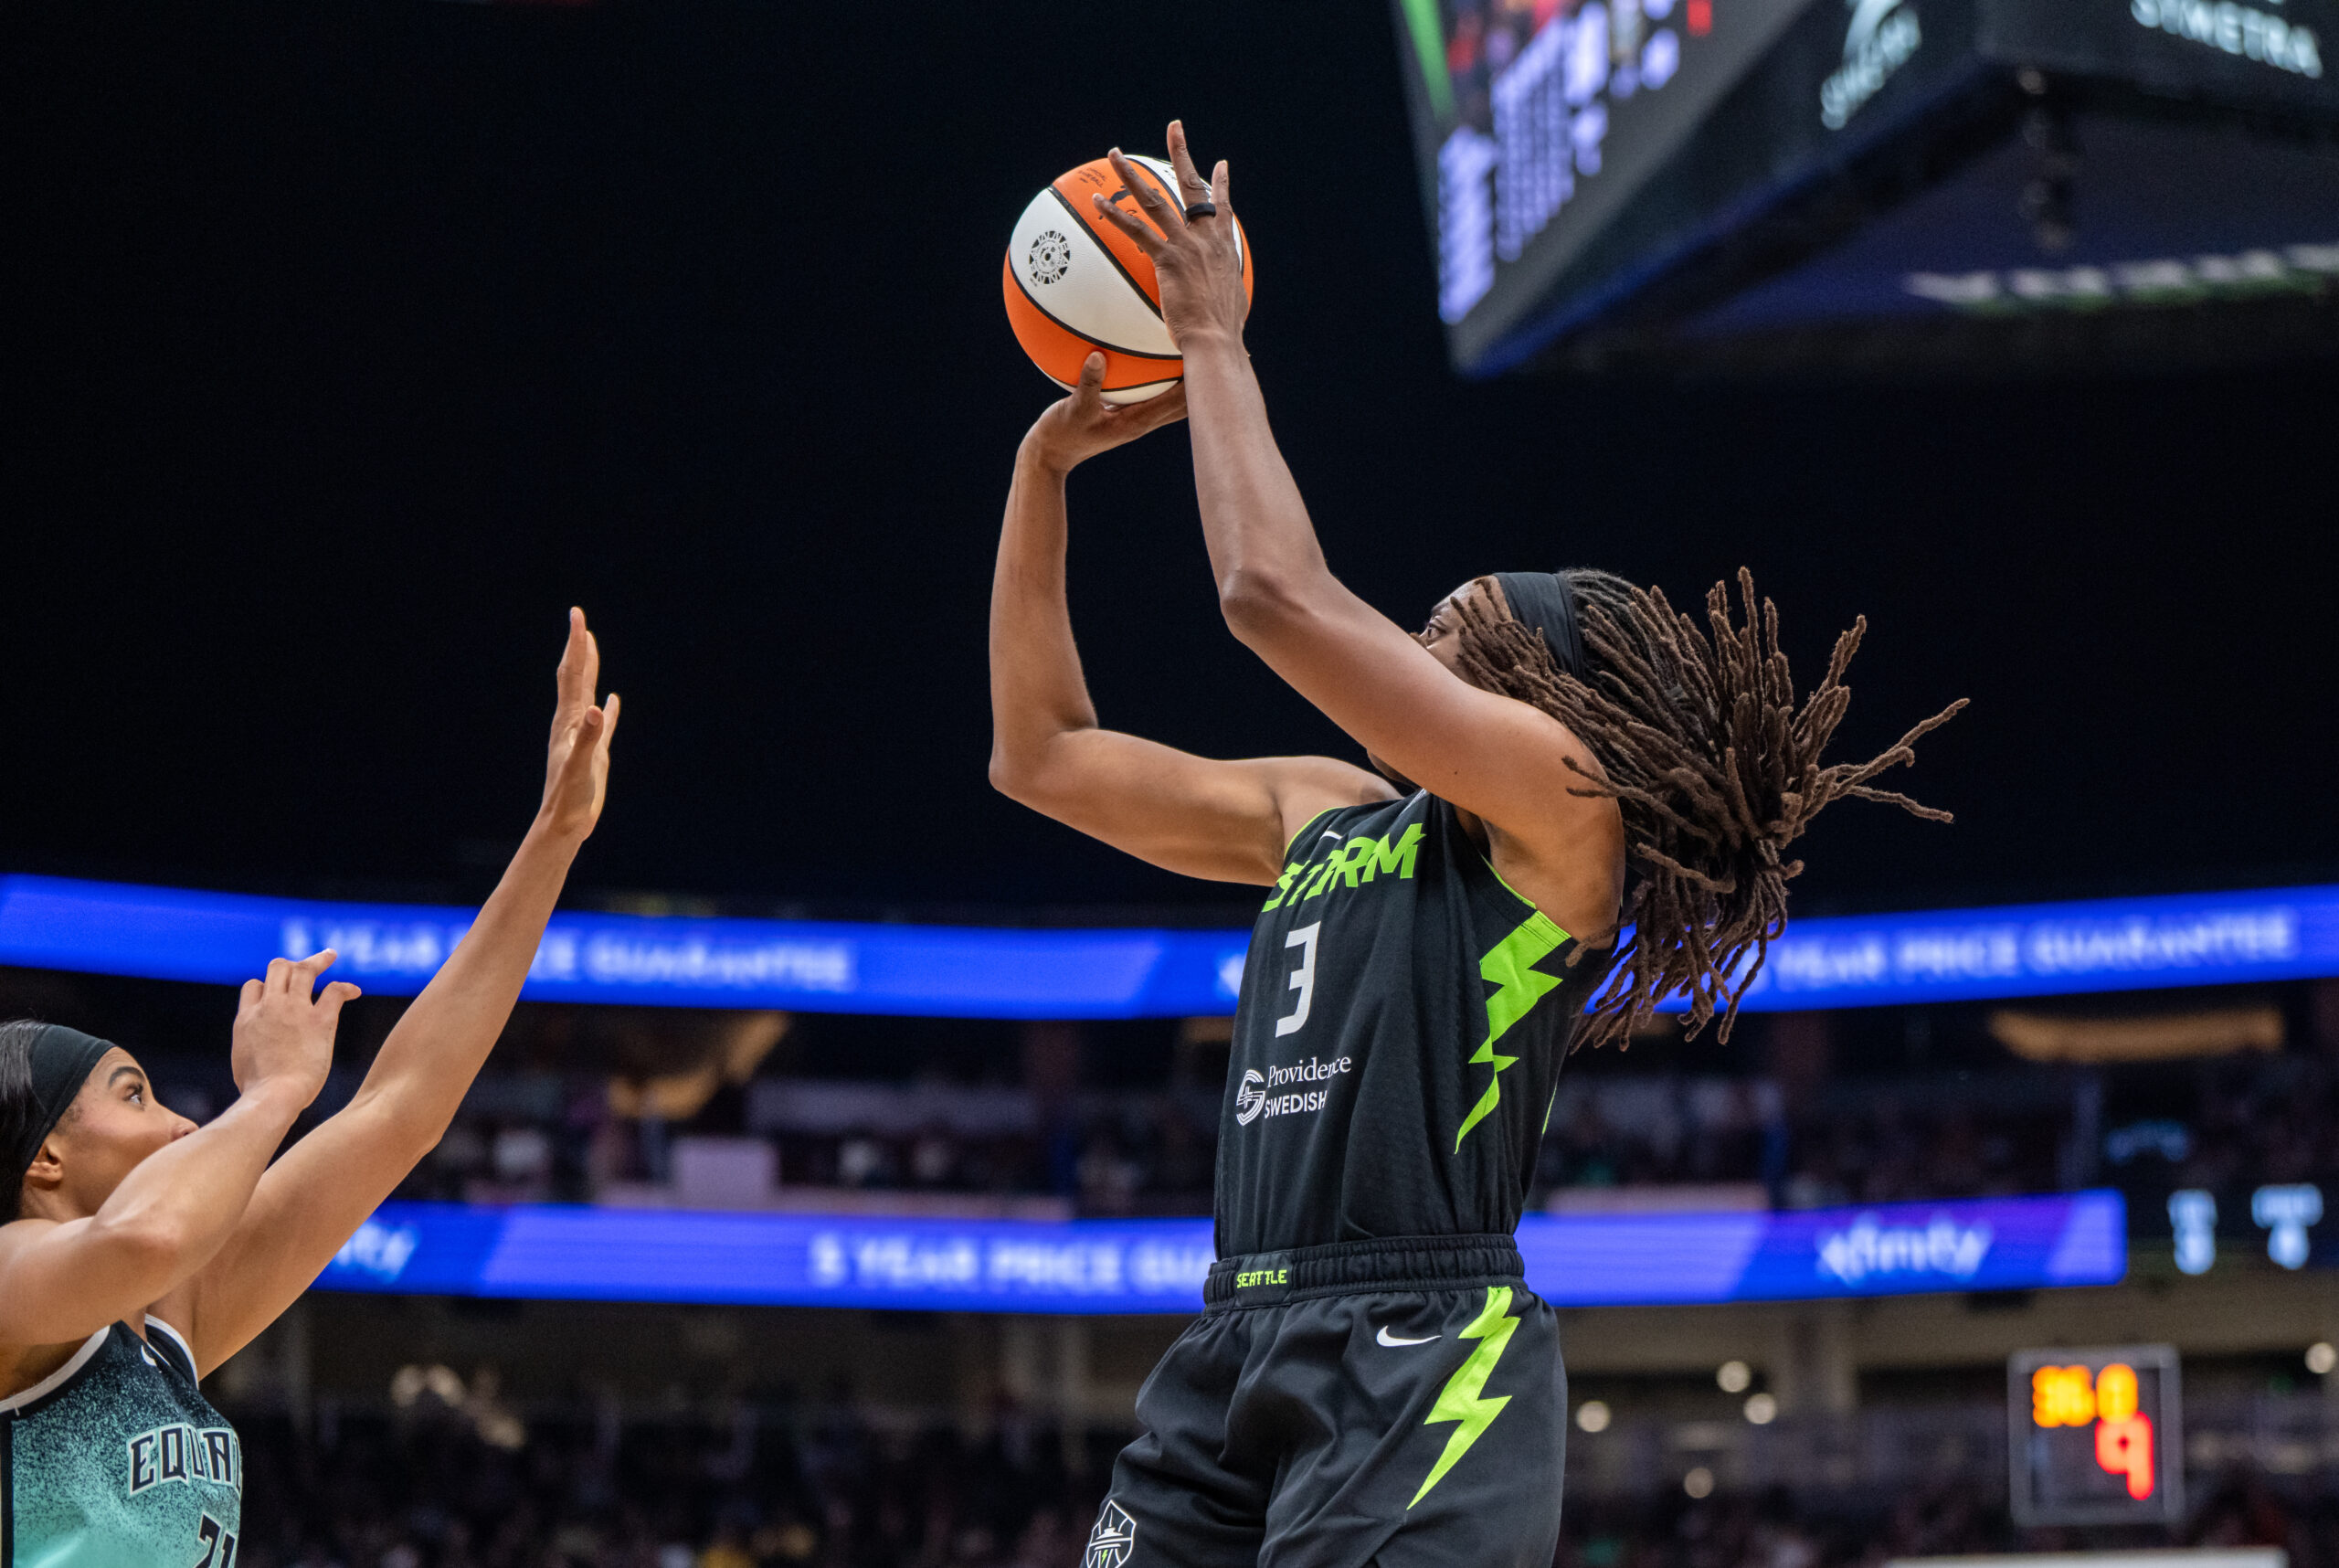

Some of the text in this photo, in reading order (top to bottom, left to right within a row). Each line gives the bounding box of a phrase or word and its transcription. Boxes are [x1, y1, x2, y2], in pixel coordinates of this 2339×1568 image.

[1262, 823, 1426, 912] STORM
[585, 934, 851, 990] GUARANTEE
[1898, 928, 2019, 977] PRICE
[2029, 909, 2295, 972] GUARANTEE
[1275, 921, 1321, 1038] 3
[1267, 1056, 1351, 1088] Providence
[1265, 1090, 1328, 1118] SWEDISH
[857, 1236, 979, 1289] YEAR
[988, 1241, 1124, 1292] PRICE
[1236, 1269, 1287, 1288] SEATTLE
